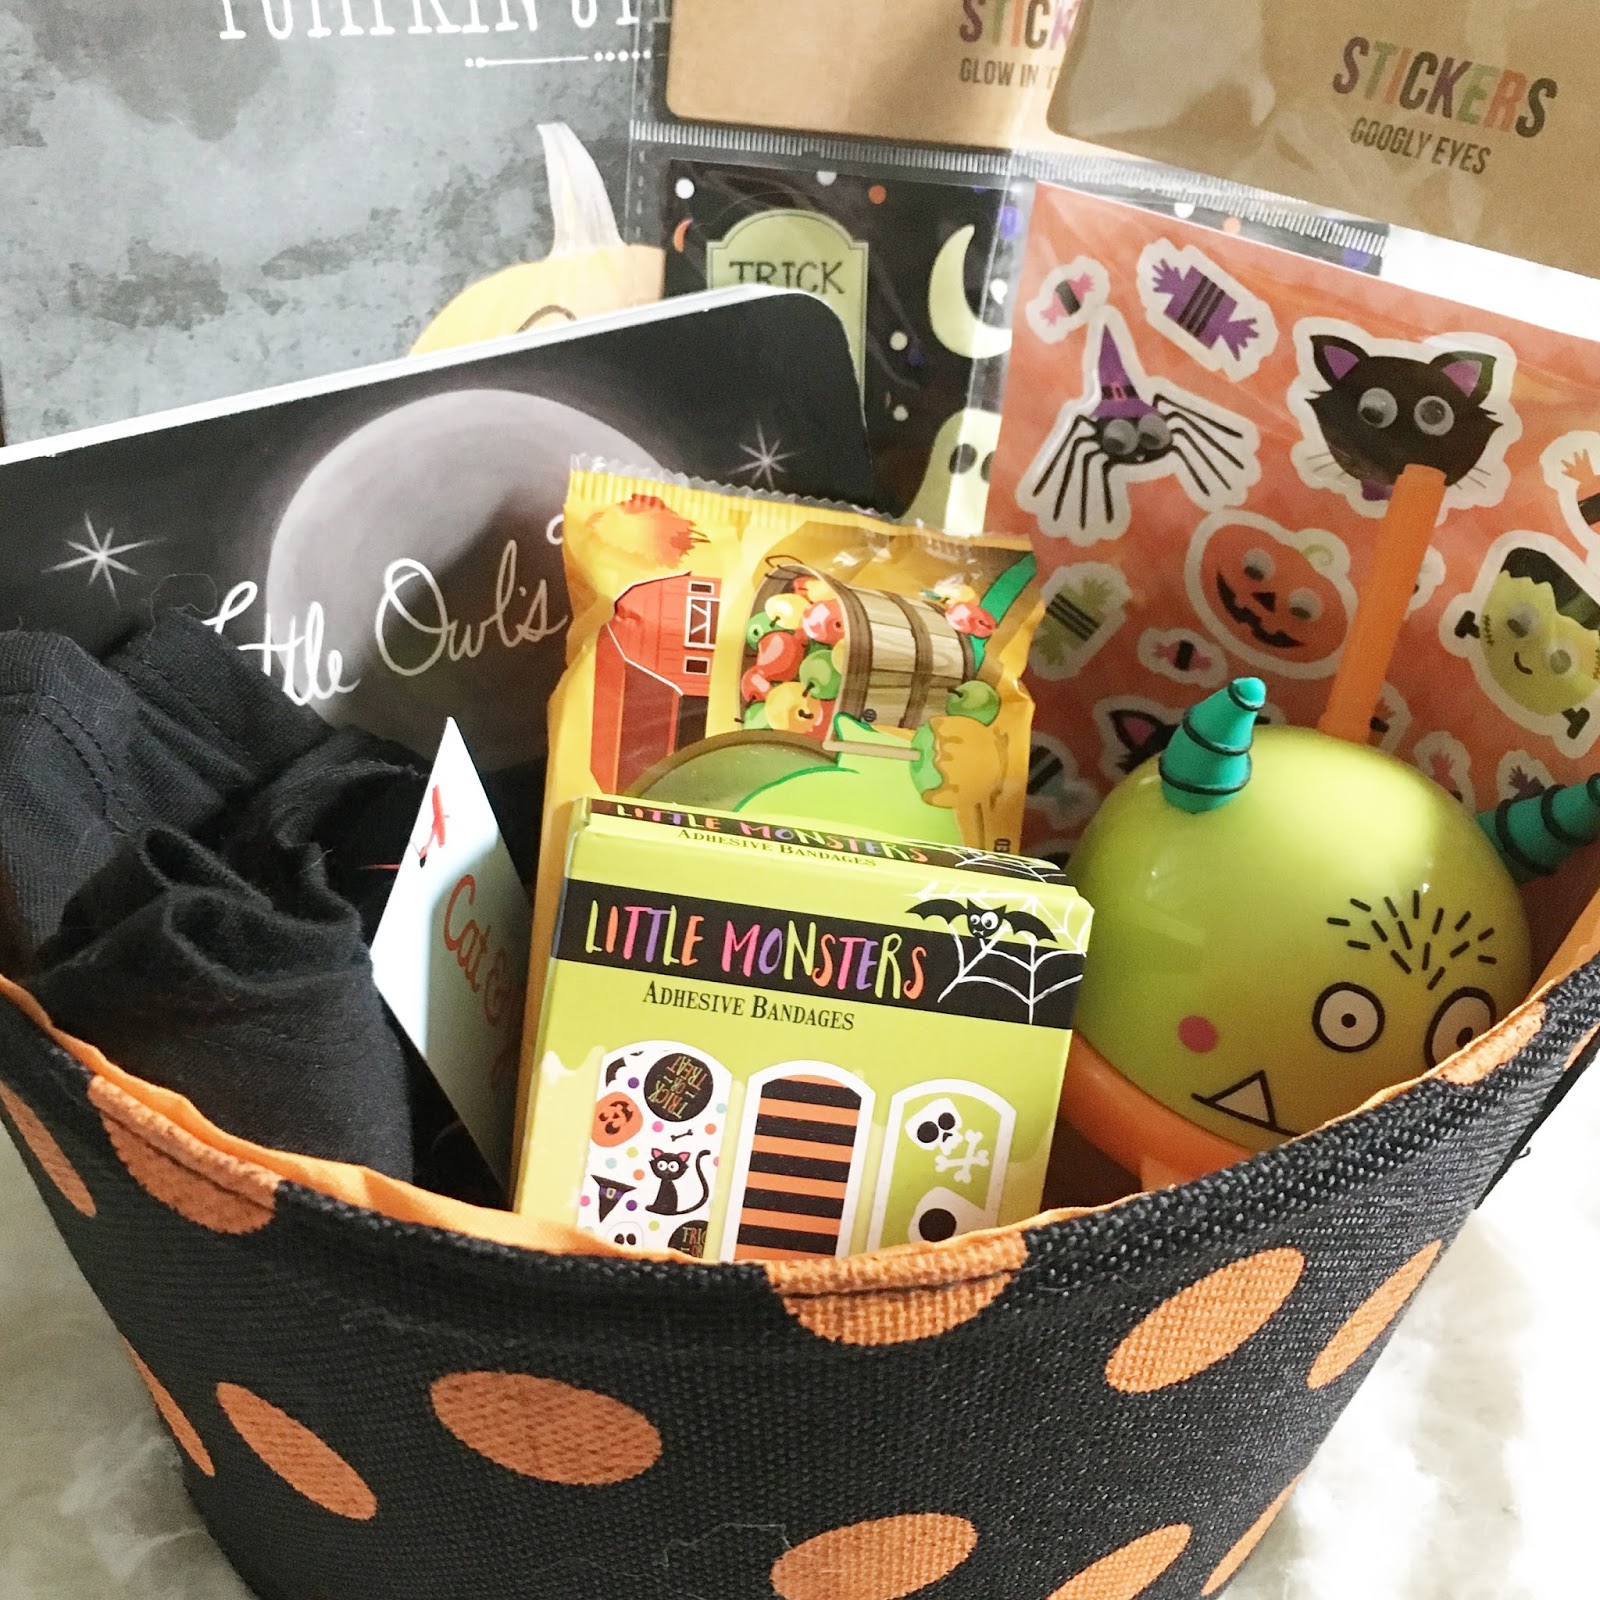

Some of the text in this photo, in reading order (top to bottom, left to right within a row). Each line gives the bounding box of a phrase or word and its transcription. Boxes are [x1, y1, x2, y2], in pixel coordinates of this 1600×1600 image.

[959, 57, 1015, 86] GLOW
[1020, 63, 1039, 87] IN
[1333, 36, 1558, 138] STICKERS
[1350, 117, 1492, 175] GOOGLY EYES
[729, 260, 845, 294] TRICK
[375, 540, 568, 676] Owl's
[616, 804, 929, 862] LITTLE MONSTERS
[677, 829, 877, 867] ADHESIVE BANDAGES
[444, 874, 492, 994] Cat
[585, 899, 927, 1000] LITTLE MONSTERS
[643, 980, 855, 1032] ADHESIVE BANDAGES
[647, 1080, 689, 1119] TRICK
[666, 1055, 708, 1091] TREAT
